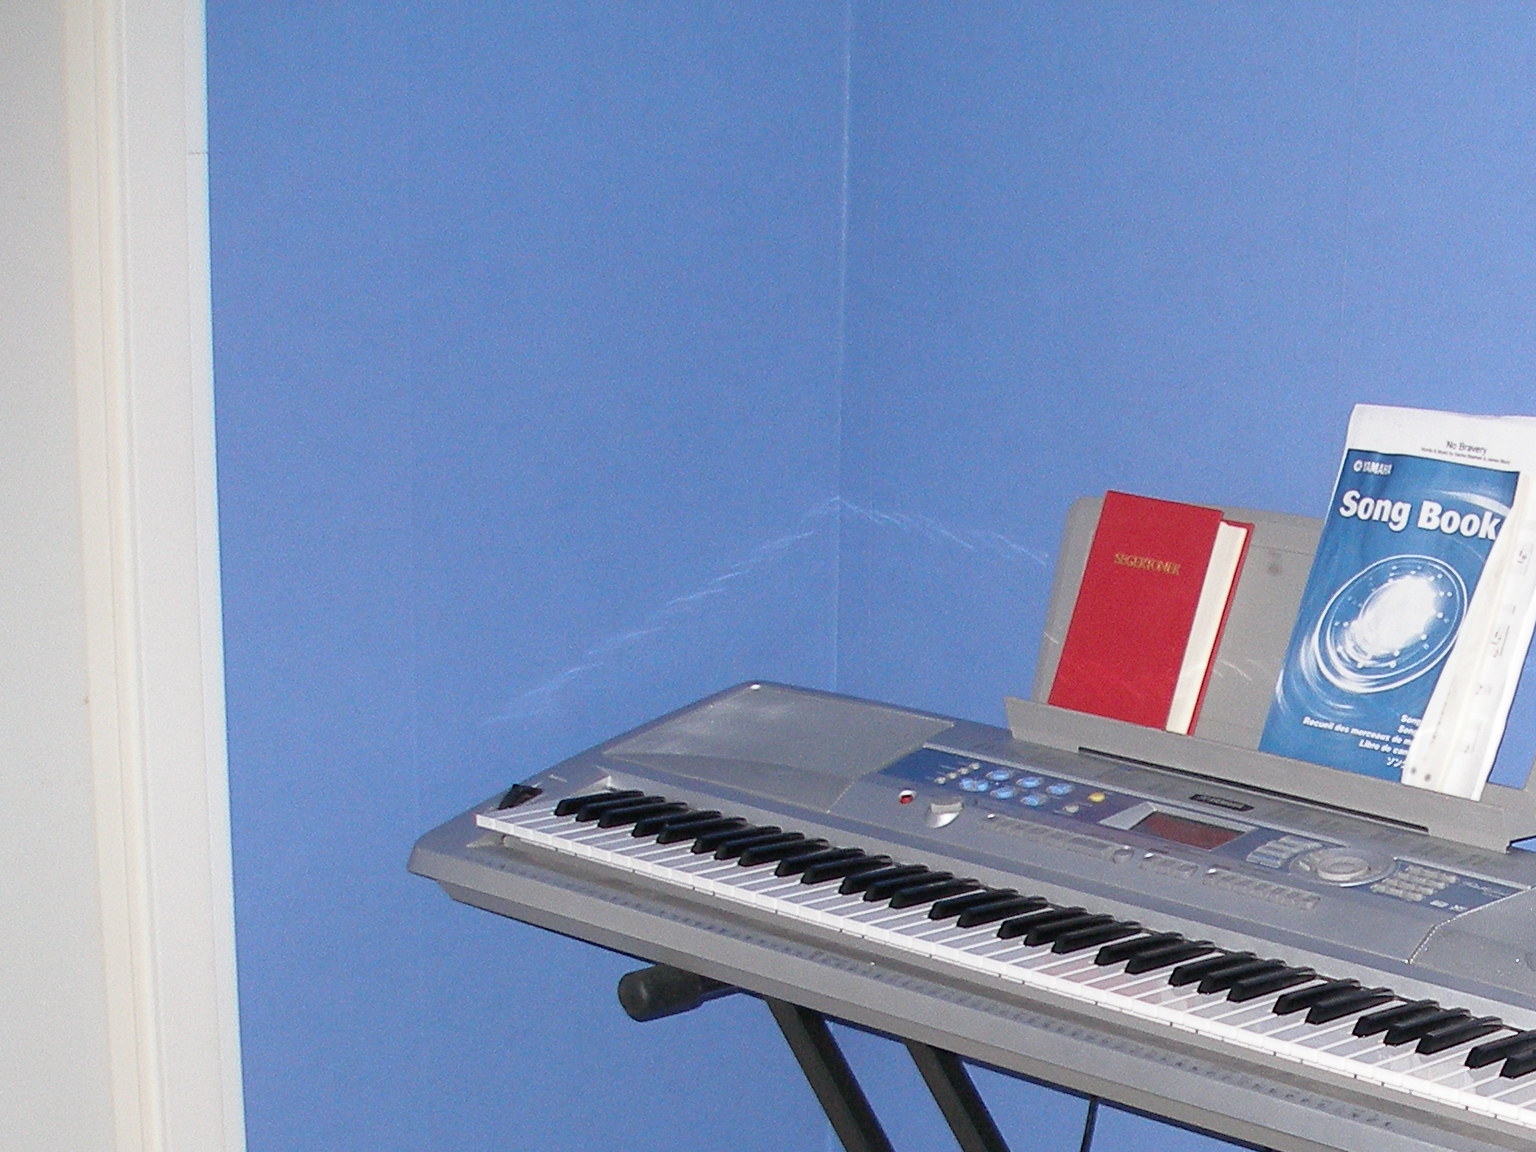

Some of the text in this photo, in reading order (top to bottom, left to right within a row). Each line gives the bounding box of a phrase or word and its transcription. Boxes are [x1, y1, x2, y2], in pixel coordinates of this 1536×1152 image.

[1446, 441, 1488, 455] No Bravery
[1362, 461, 1393, 476] YAMAHA
[1338, 489, 1500, 541] Song Book
[1302, 716, 1335, 730] Recueil
[1334, 723, 1350, 733] des
[1391, 734, 1403, 744] de
[1359, 739, 1380, 751] Libre
[1381, 744, 1392, 753] de
